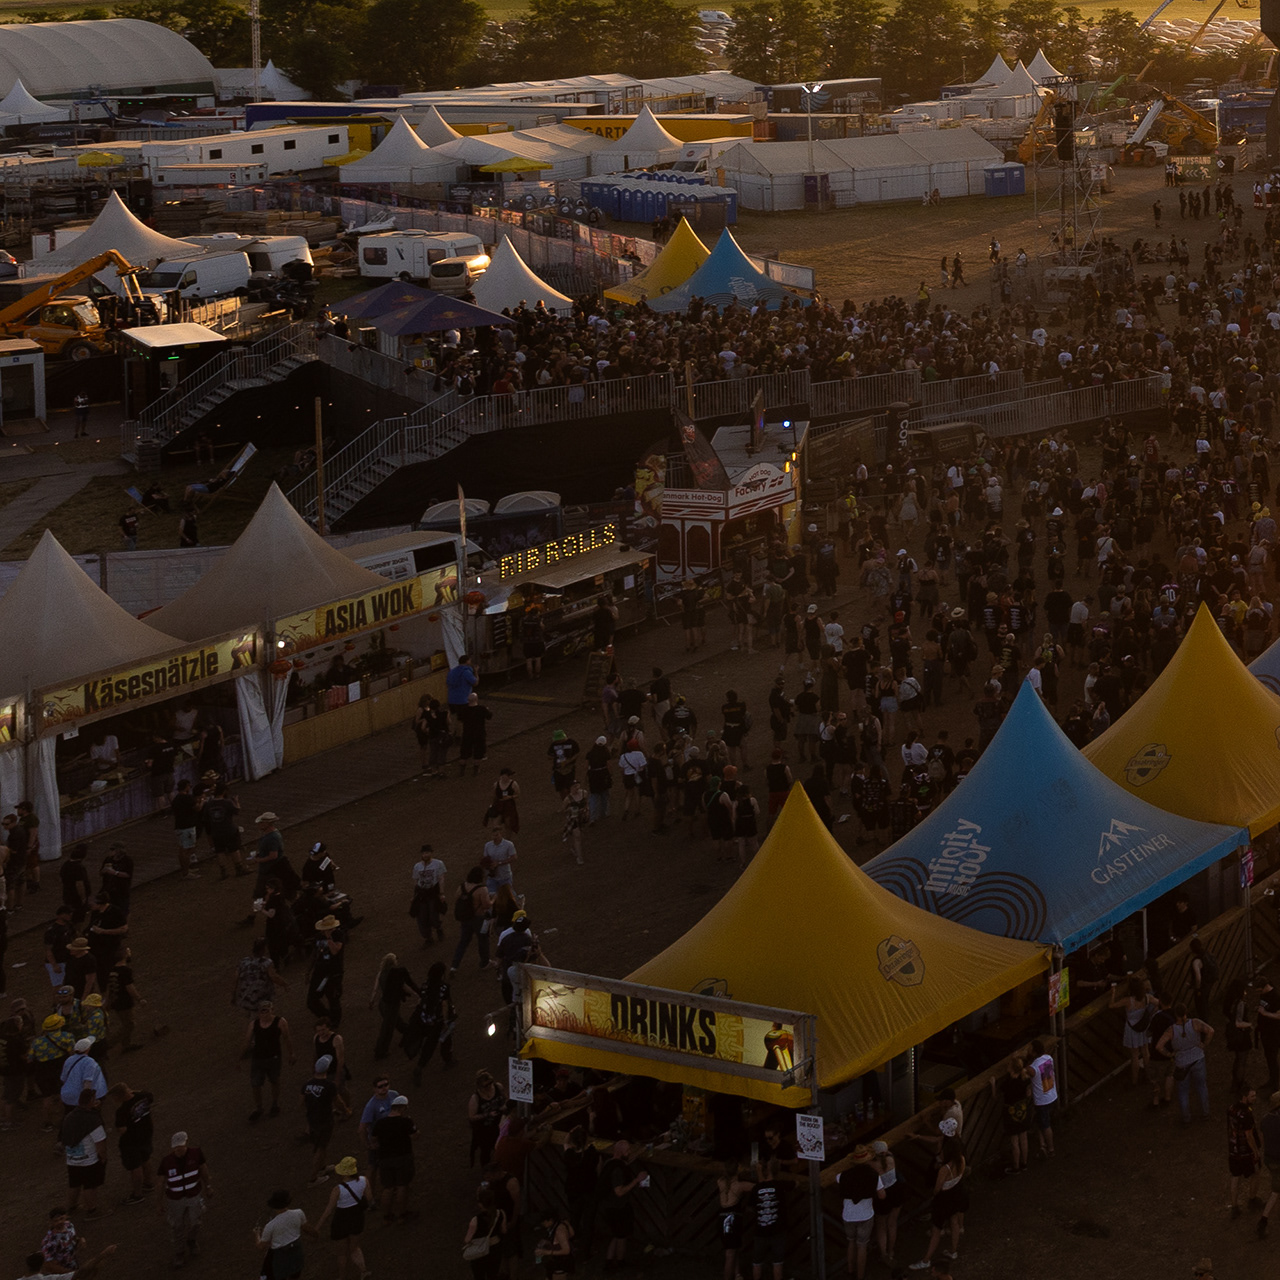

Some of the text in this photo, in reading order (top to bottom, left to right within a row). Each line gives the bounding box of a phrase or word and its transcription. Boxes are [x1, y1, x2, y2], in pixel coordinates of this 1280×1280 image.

[691, 492, 722, 503] Hot-Dog
[500, 522, 616, 579] RIB ROLLS
[325, 583, 415, 638] ASIA WOK
[83, 649, 219, 714] Käsespätzle
[1090, 832, 1177, 886] GASTEINER
[611, 994, 717, 1055] DRINKS
